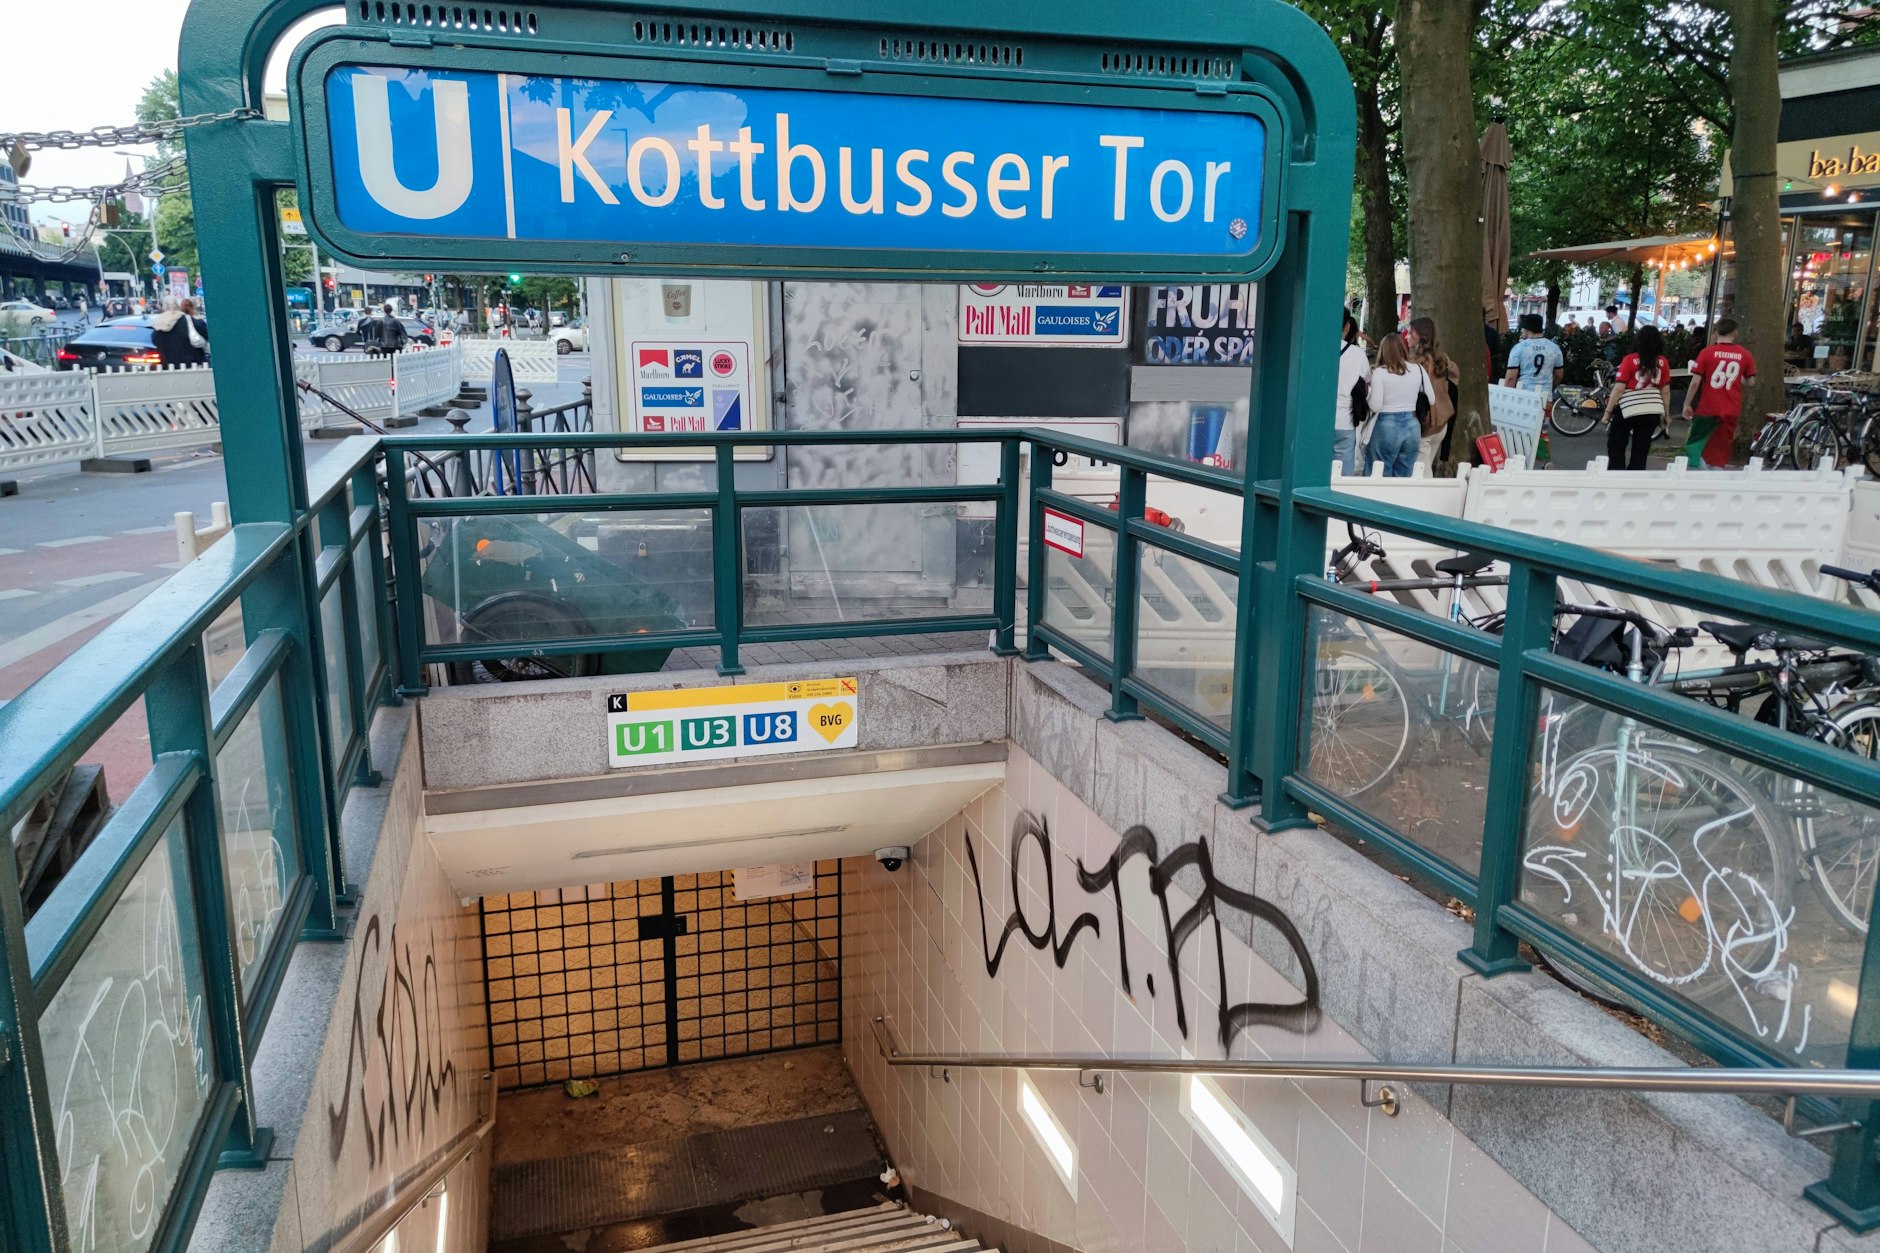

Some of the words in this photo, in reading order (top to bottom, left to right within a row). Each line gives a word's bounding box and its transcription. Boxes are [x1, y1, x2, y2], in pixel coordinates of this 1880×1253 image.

[352, 73, 474, 220] U
[556, 107, 1069, 219] Kottbusser
[1099, 134, 1231, 224] Tor
[965, 305, 995, 335] Pall
[999, 305, 1031, 335] Mall
[1037, 316, 1091, 326] GAULOISES
[675, 353, 701, 363] CAMEL
[1714, 350, 1742, 361] PEIXINHO
[1533, 353, 1545, 377] 9
[640, 369, 670, 379] Marlboro
[1710, 359, 1740, 390] 69
[612, 697, 623, 709] K
[819, 714, 842, 727] BVG
[623, 724, 665, 752] U1
[688, 719, 730, 747] U3
[749, 714, 793, 742] U8
